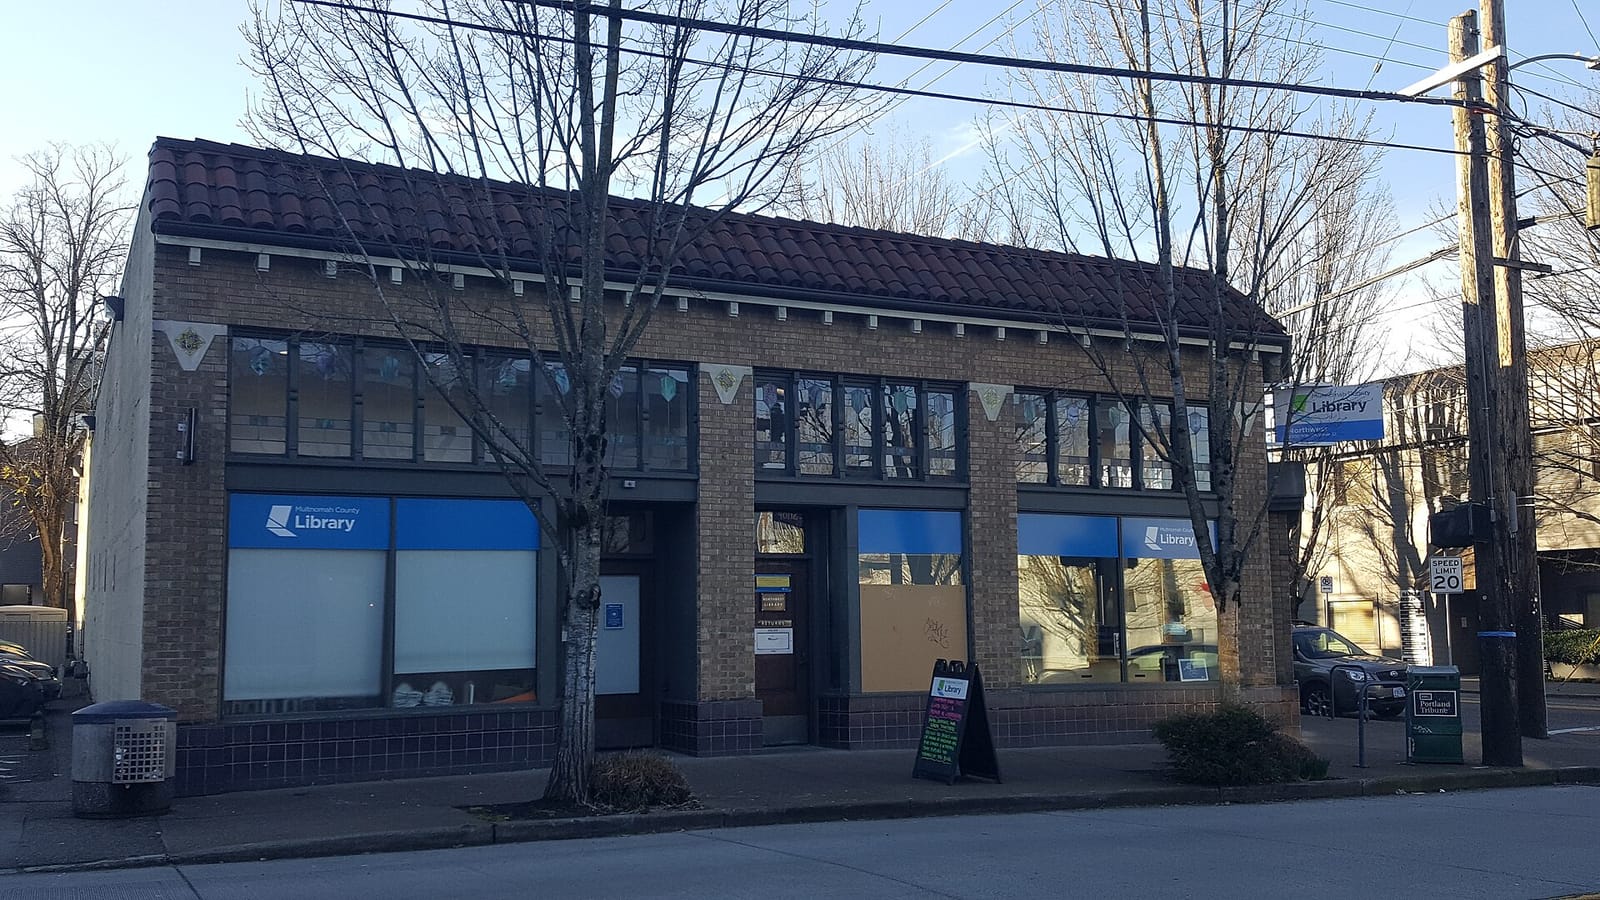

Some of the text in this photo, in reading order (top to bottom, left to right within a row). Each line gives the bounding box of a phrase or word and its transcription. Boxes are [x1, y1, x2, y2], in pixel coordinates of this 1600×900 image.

[1312, 401, 1367, 413] Library
[334, 506, 360, 515] County
[295, 515, 356, 532] Library
[1160, 533, 1194, 547] Library
[1434, 575, 1459, 589] 20
[944, 684, 961, 695] Library
